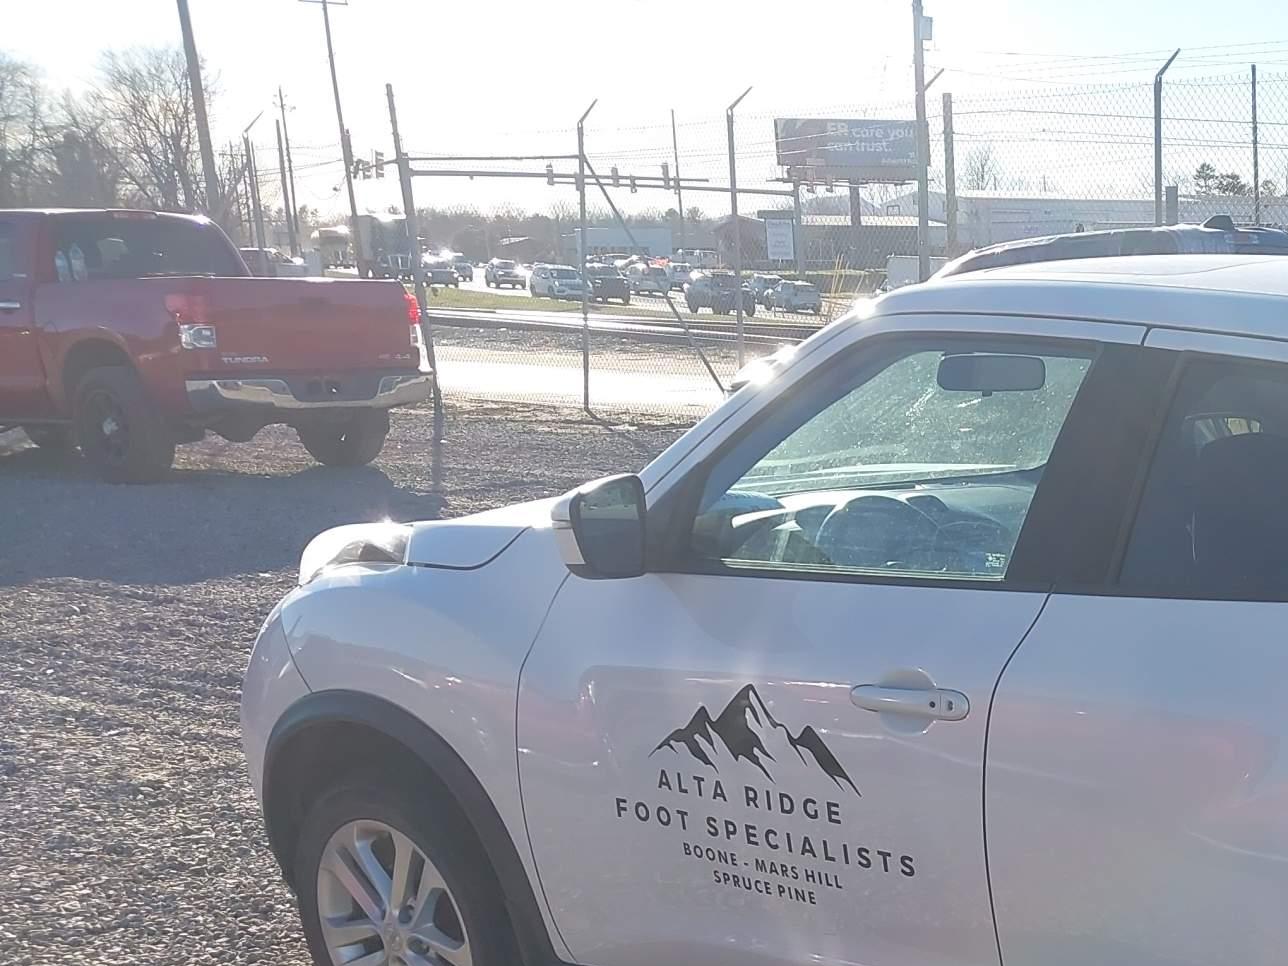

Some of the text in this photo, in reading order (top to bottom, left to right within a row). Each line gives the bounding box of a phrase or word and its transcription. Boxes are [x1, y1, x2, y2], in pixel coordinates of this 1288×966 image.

[887, 126, 913, 141] you
[657, 768, 843, 825] ALTA RIDGE
[614, 796, 917, 877] FOOT SPECIALISTS
[682, 841, 738, 867] BOONE
[755, 858, 800, 881] MARS
[804, 869, 843, 890] HILL
[712, 869, 818, 906] SPRUCE PINE
